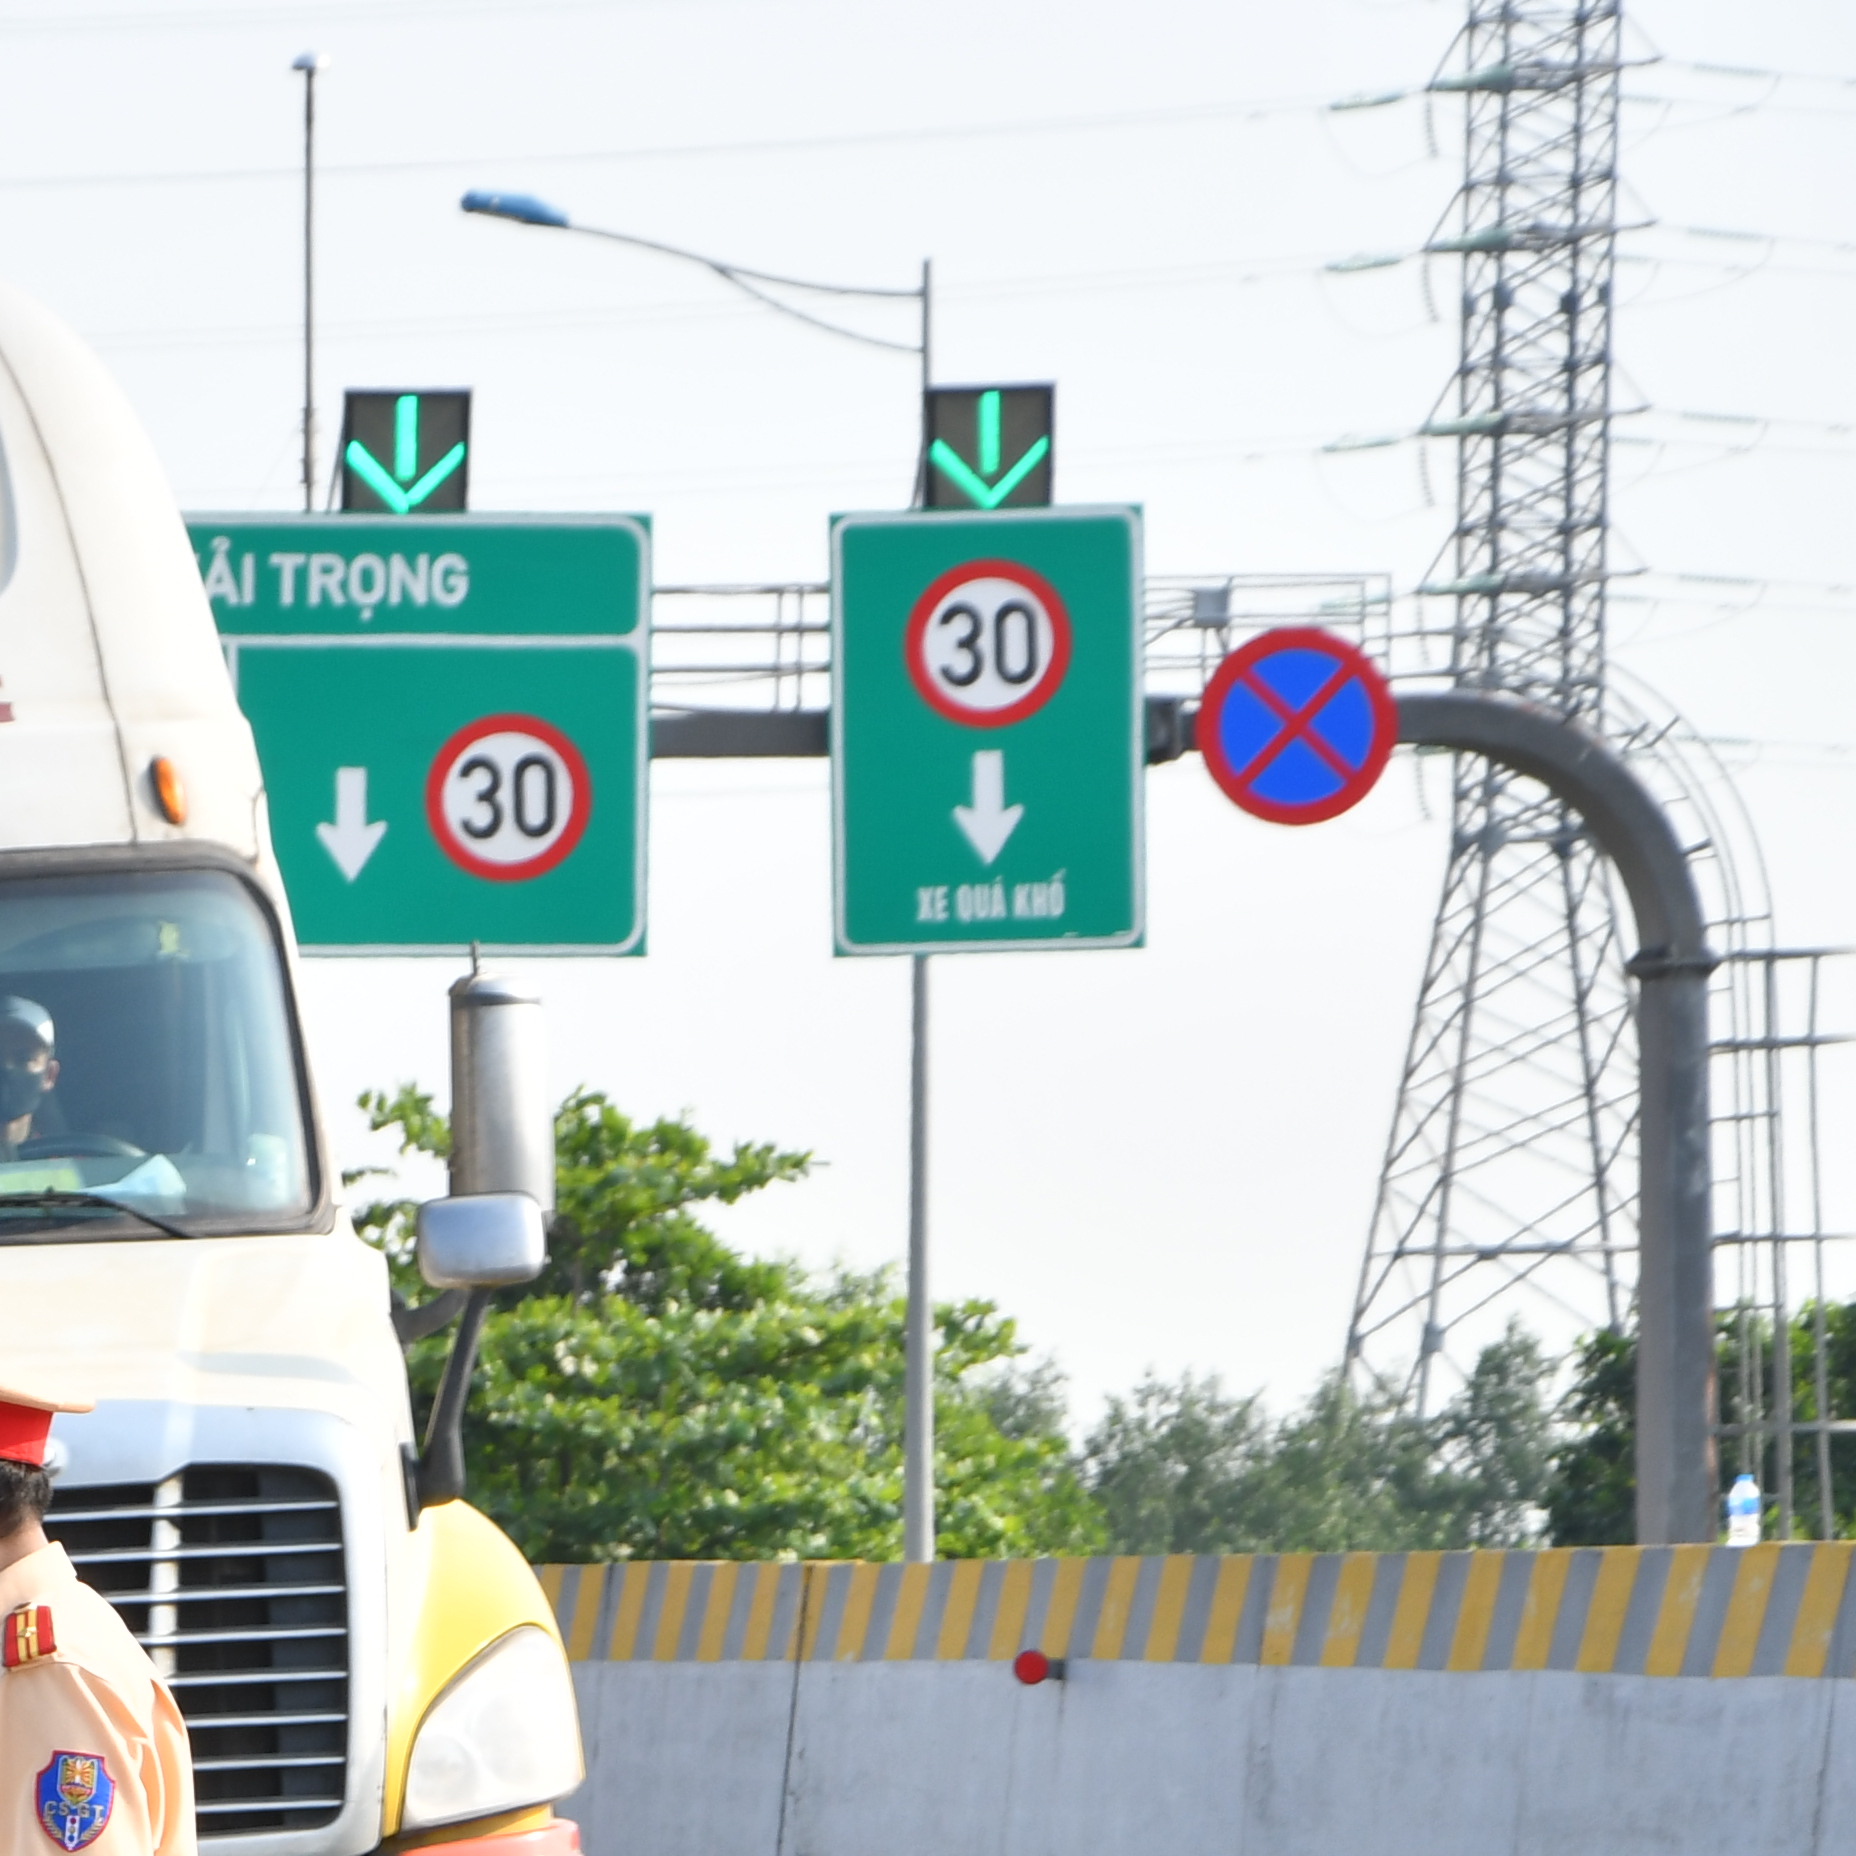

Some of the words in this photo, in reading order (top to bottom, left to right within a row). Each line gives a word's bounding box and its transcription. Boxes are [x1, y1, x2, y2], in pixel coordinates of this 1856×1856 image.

[195, 537, 256, 606] ẢI
[268, 552, 470, 622] TRỌNG
[939, 599, 1038, 687] 30
[459, 752, 557, 839] 30
[917, 884, 950, 921] XE
